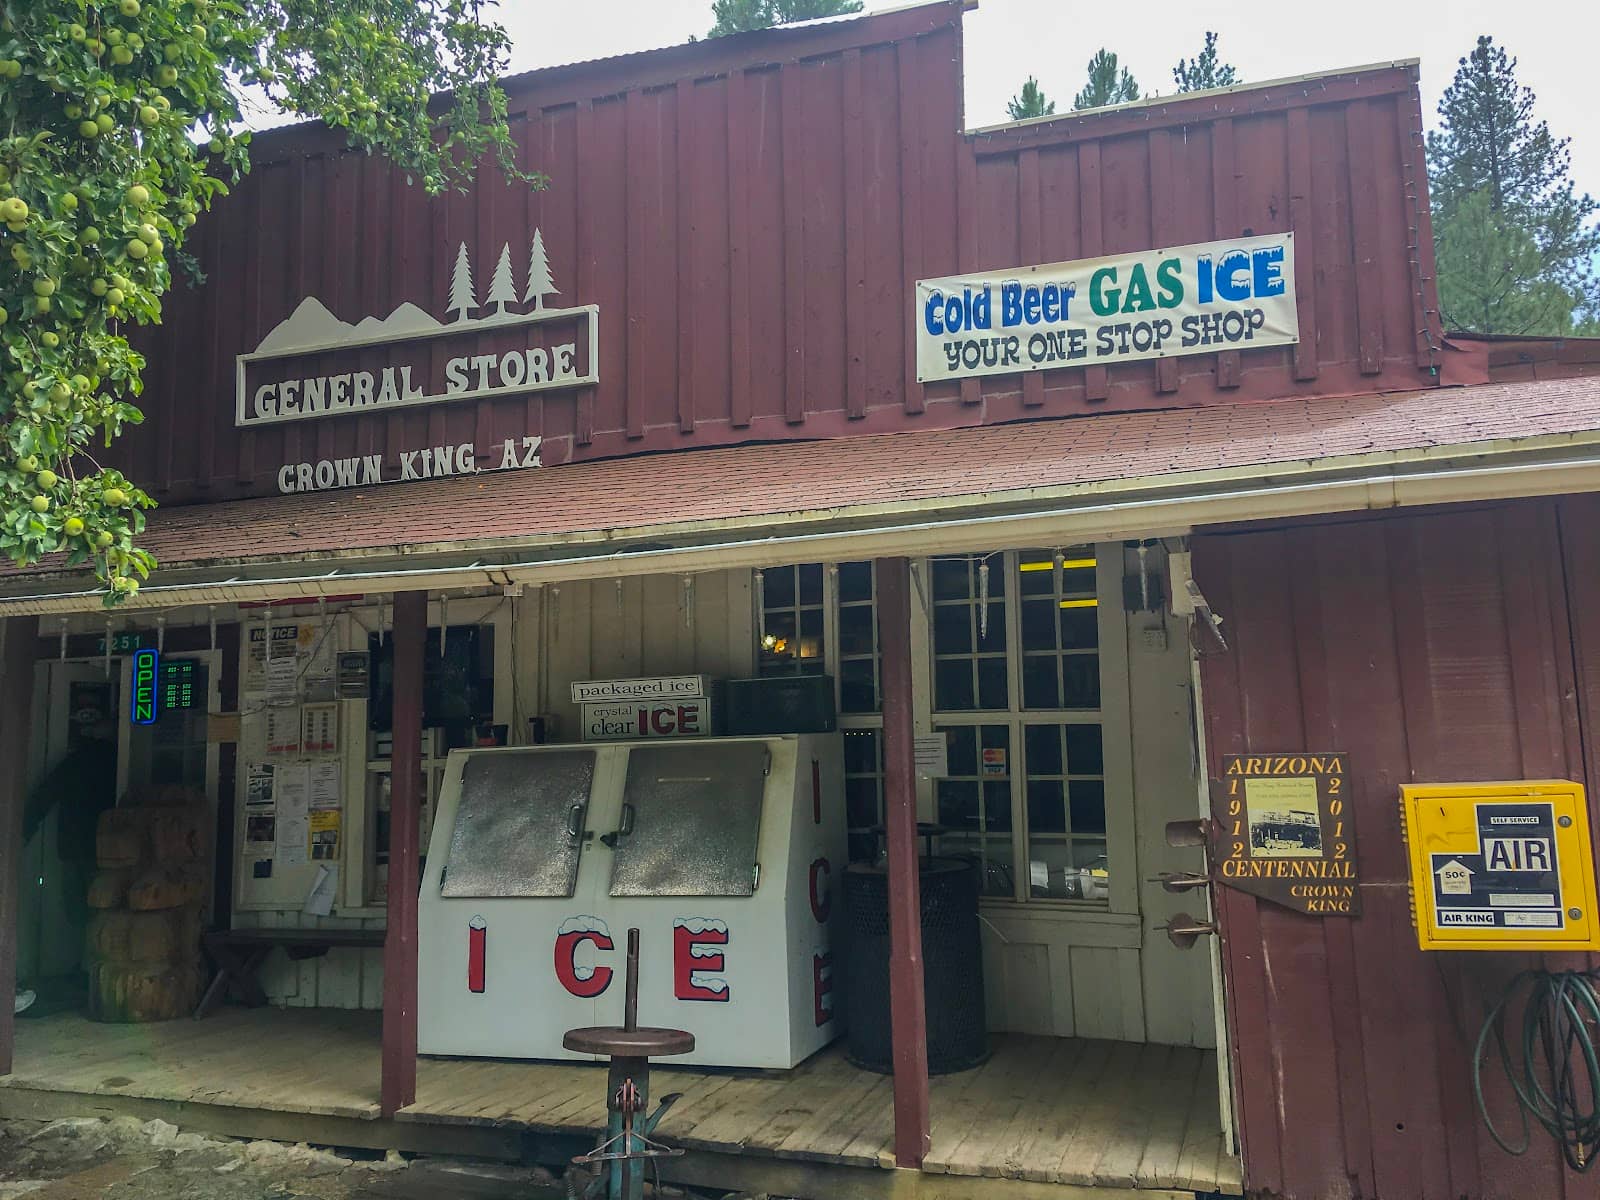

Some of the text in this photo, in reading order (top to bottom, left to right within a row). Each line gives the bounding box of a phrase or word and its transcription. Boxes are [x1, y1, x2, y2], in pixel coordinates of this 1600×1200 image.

[924, 245, 1285, 336] Cold Beer GAS ICE
[943, 308, 1265, 372] YOUR ONE STOP SHOP
[254, 343, 577, 419] GENERAL STORE
[278, 436, 543, 494] CROWN KING, AZ
[137, 654, 153, 720] OPEN
[579, 681, 695, 699] packaged ice
[591, 704, 700, 736] clear ICE
[593, 705, 632, 719] crystal
[1226, 757, 1344, 775] ARIZONA
[1222, 860, 1356, 879] CENTENNIAL
[1490, 840, 1548, 870] AIR
[1290, 885, 1354, 898] CROWN
[1307, 900, 1350, 912] KING
[1444, 914, 1493, 923] AIR KING
[468, 915, 730, 1002] ICE
